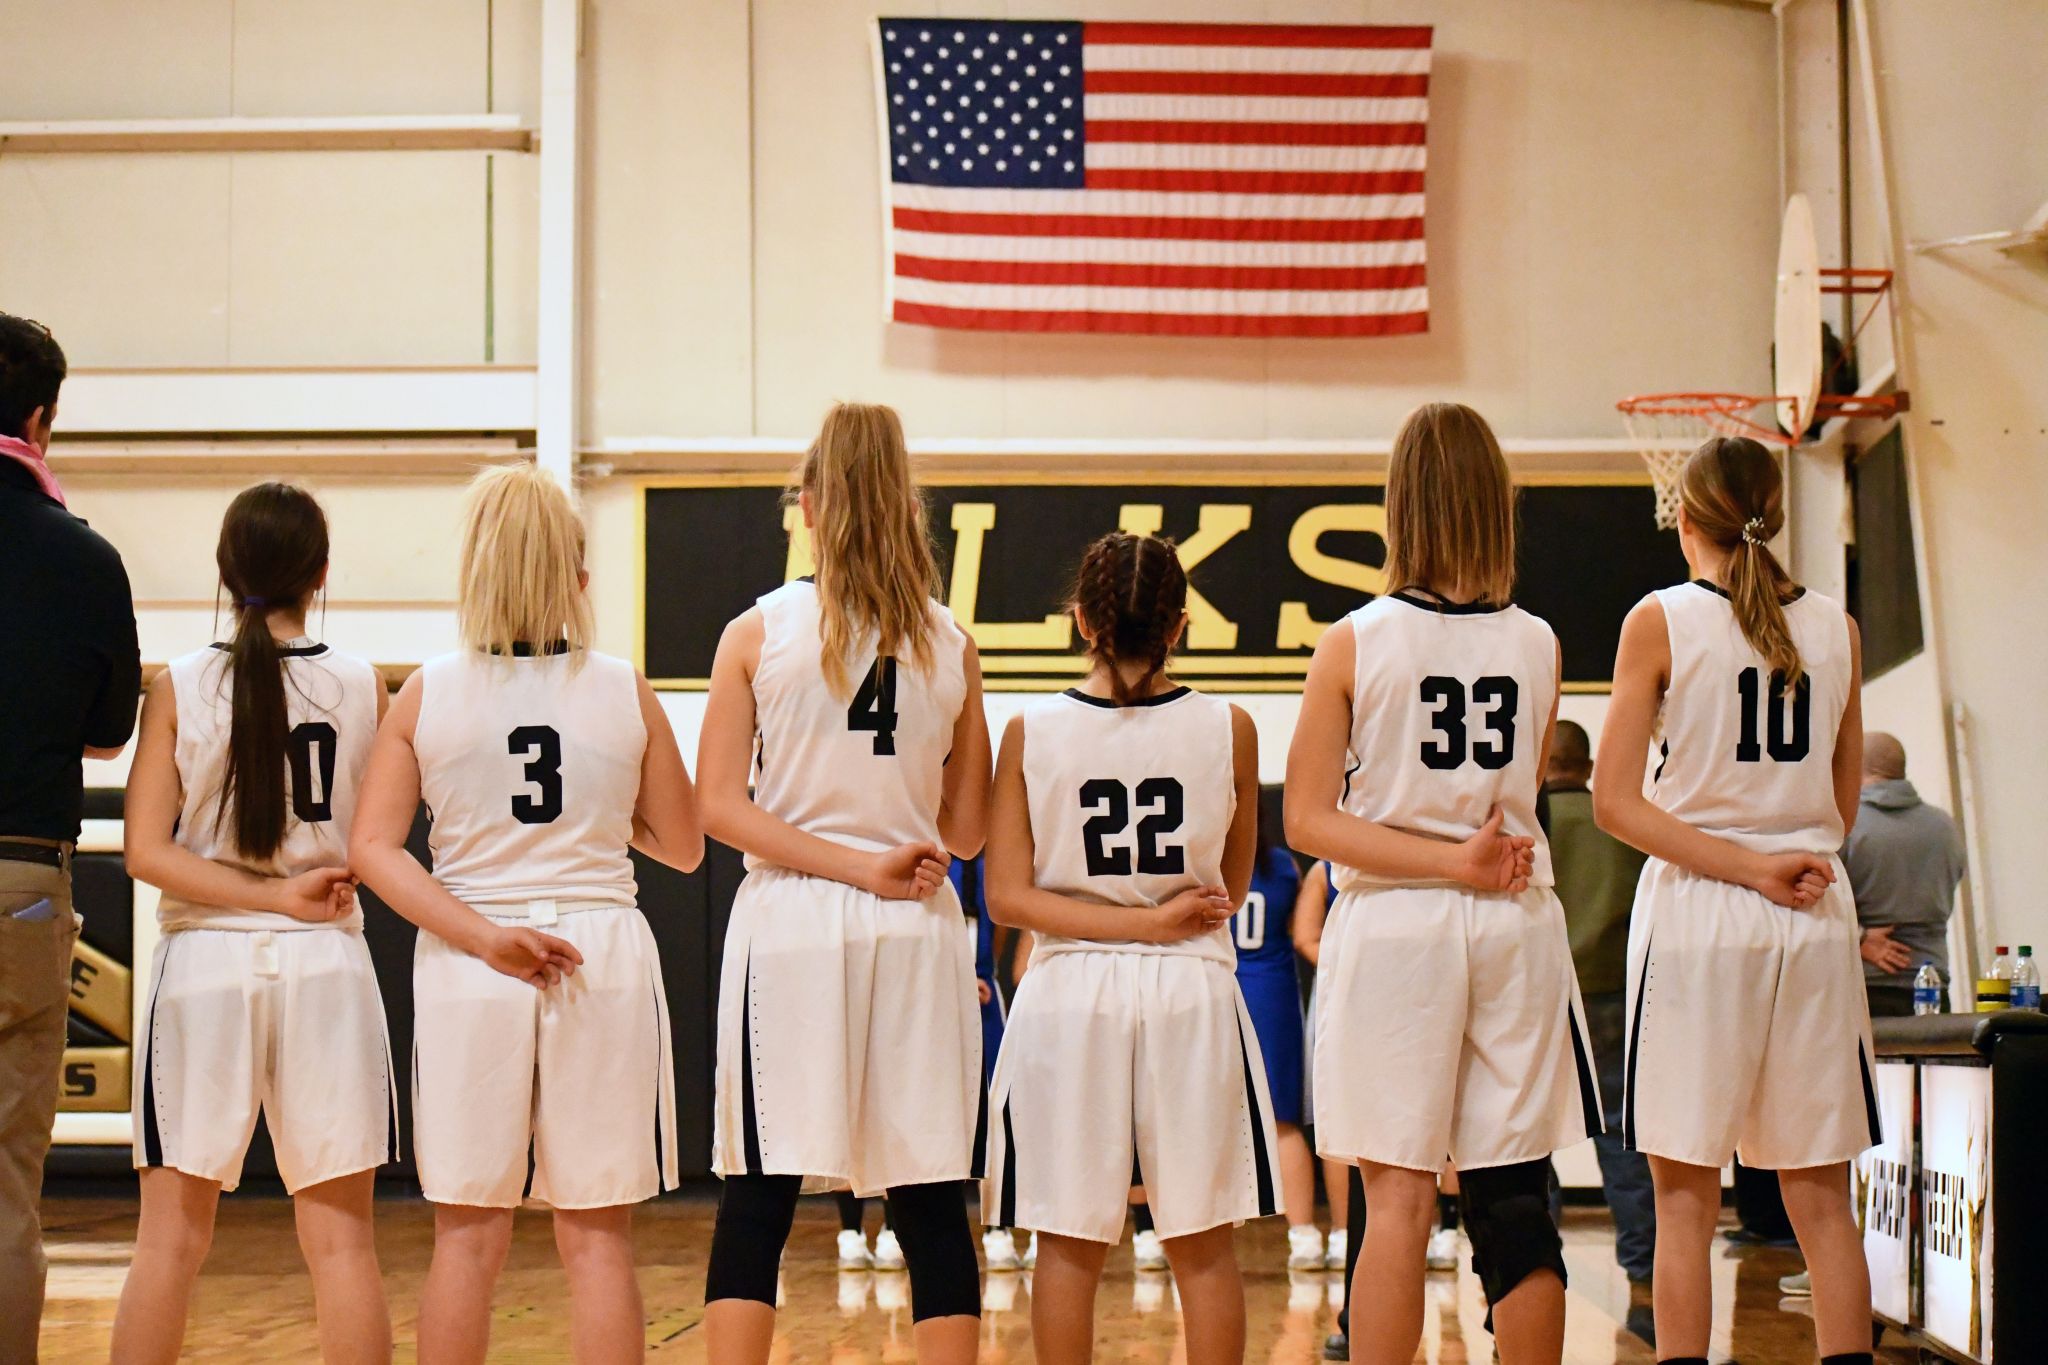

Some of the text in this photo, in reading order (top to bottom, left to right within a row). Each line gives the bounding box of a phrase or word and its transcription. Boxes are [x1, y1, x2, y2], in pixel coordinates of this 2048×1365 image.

[783, 503, 1391, 650] LKS
[848, 655, 898, 755] 4
[1420, 676, 1518, 769] 33
[1736, 667, 1810, 762] 10
[508, 726, 562, 824] 3
[1079, 777, 1184, 876] 22
[1940, 1173, 1964, 1260] ELKS
